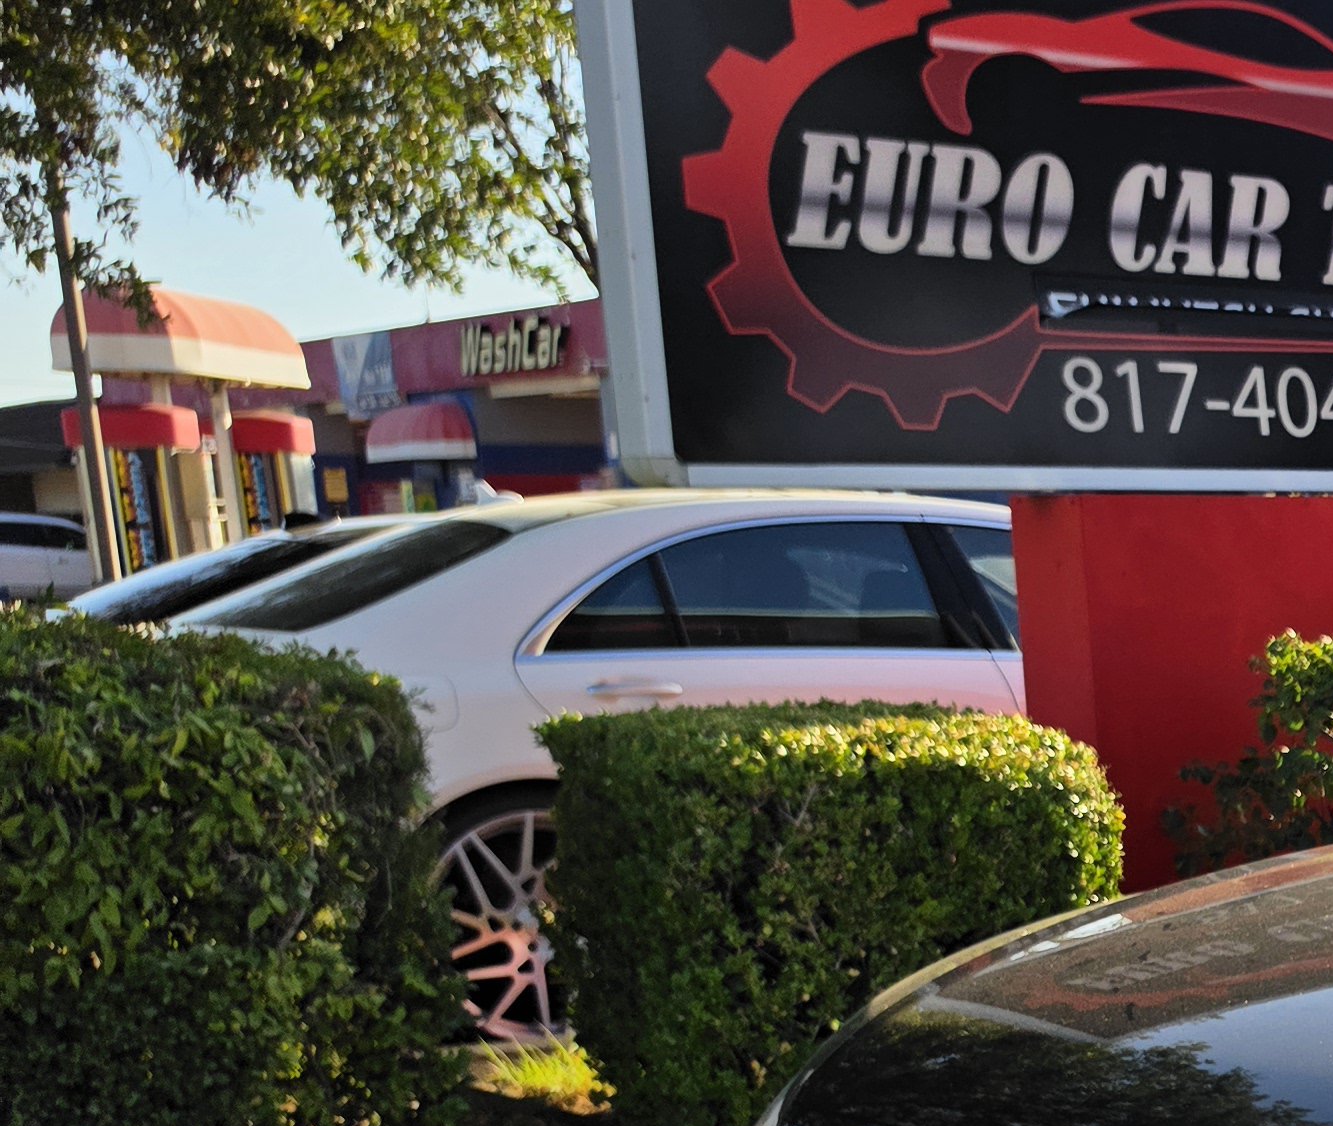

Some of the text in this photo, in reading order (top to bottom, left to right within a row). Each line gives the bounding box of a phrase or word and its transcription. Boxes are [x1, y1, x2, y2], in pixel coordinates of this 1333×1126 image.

[786, 131, 1074, 265] EURO
[1109, 163, 1290, 282] CAR
[461, 315, 561, 376] WashCar
